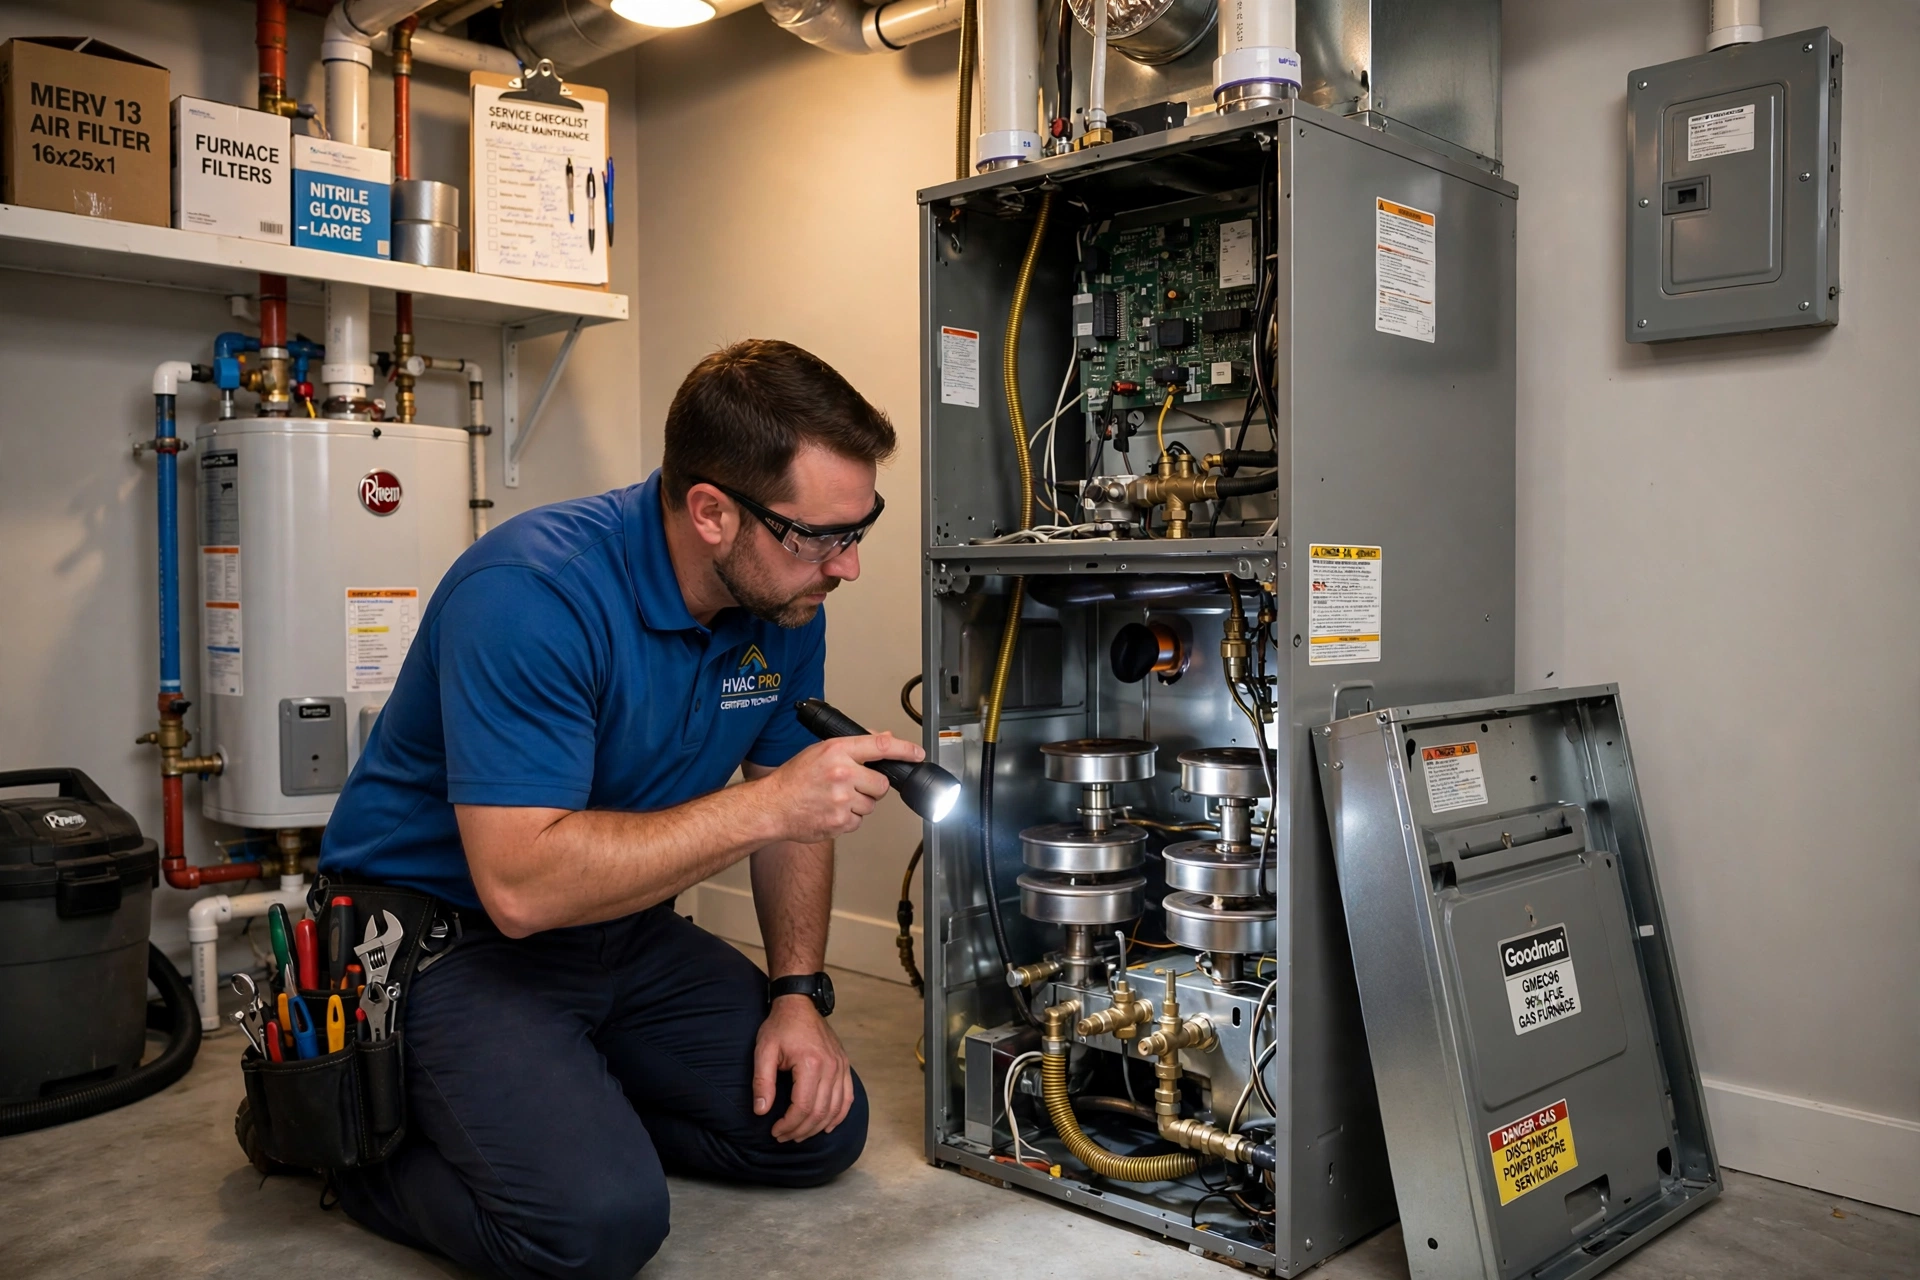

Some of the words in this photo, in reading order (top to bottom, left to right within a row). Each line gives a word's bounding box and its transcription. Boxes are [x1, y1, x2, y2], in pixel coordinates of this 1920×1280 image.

[31, 82, 107, 118] MERV
[115, 99, 142, 125] 13
[489, 107, 532, 121] SERVICE
[535, 112, 589, 129] CHECKLIST
[30, 113, 70, 139] AIR
[78, 121, 151, 153] FILTER
[490, 121, 530, 134] FURNACE
[532, 126, 590, 141] MAINTENANCE
[32, 142, 115, 174] 16x25x1
[195, 133, 279, 164] FURNACE
[202, 157, 272, 184] FILTERS
[310, 181, 369, 205] NITRILE
[309, 201, 371, 224] GLOVES
[722, 675, 755, 693] HVAC
[758, 673, 781, 689] PRO
[1505, 939, 1565, 968] Goodman
[1522, 969, 1560, 993] GMEC96
[1518, 1011, 1537, 1028] GAS
[1537, 998, 1576, 1022] FURNACE
[1503, 1155, 1535, 1181] POWER
[1535, 1139, 1567, 1164] BEFORE
[1514, 1160, 1559, 1192] SERVICING
